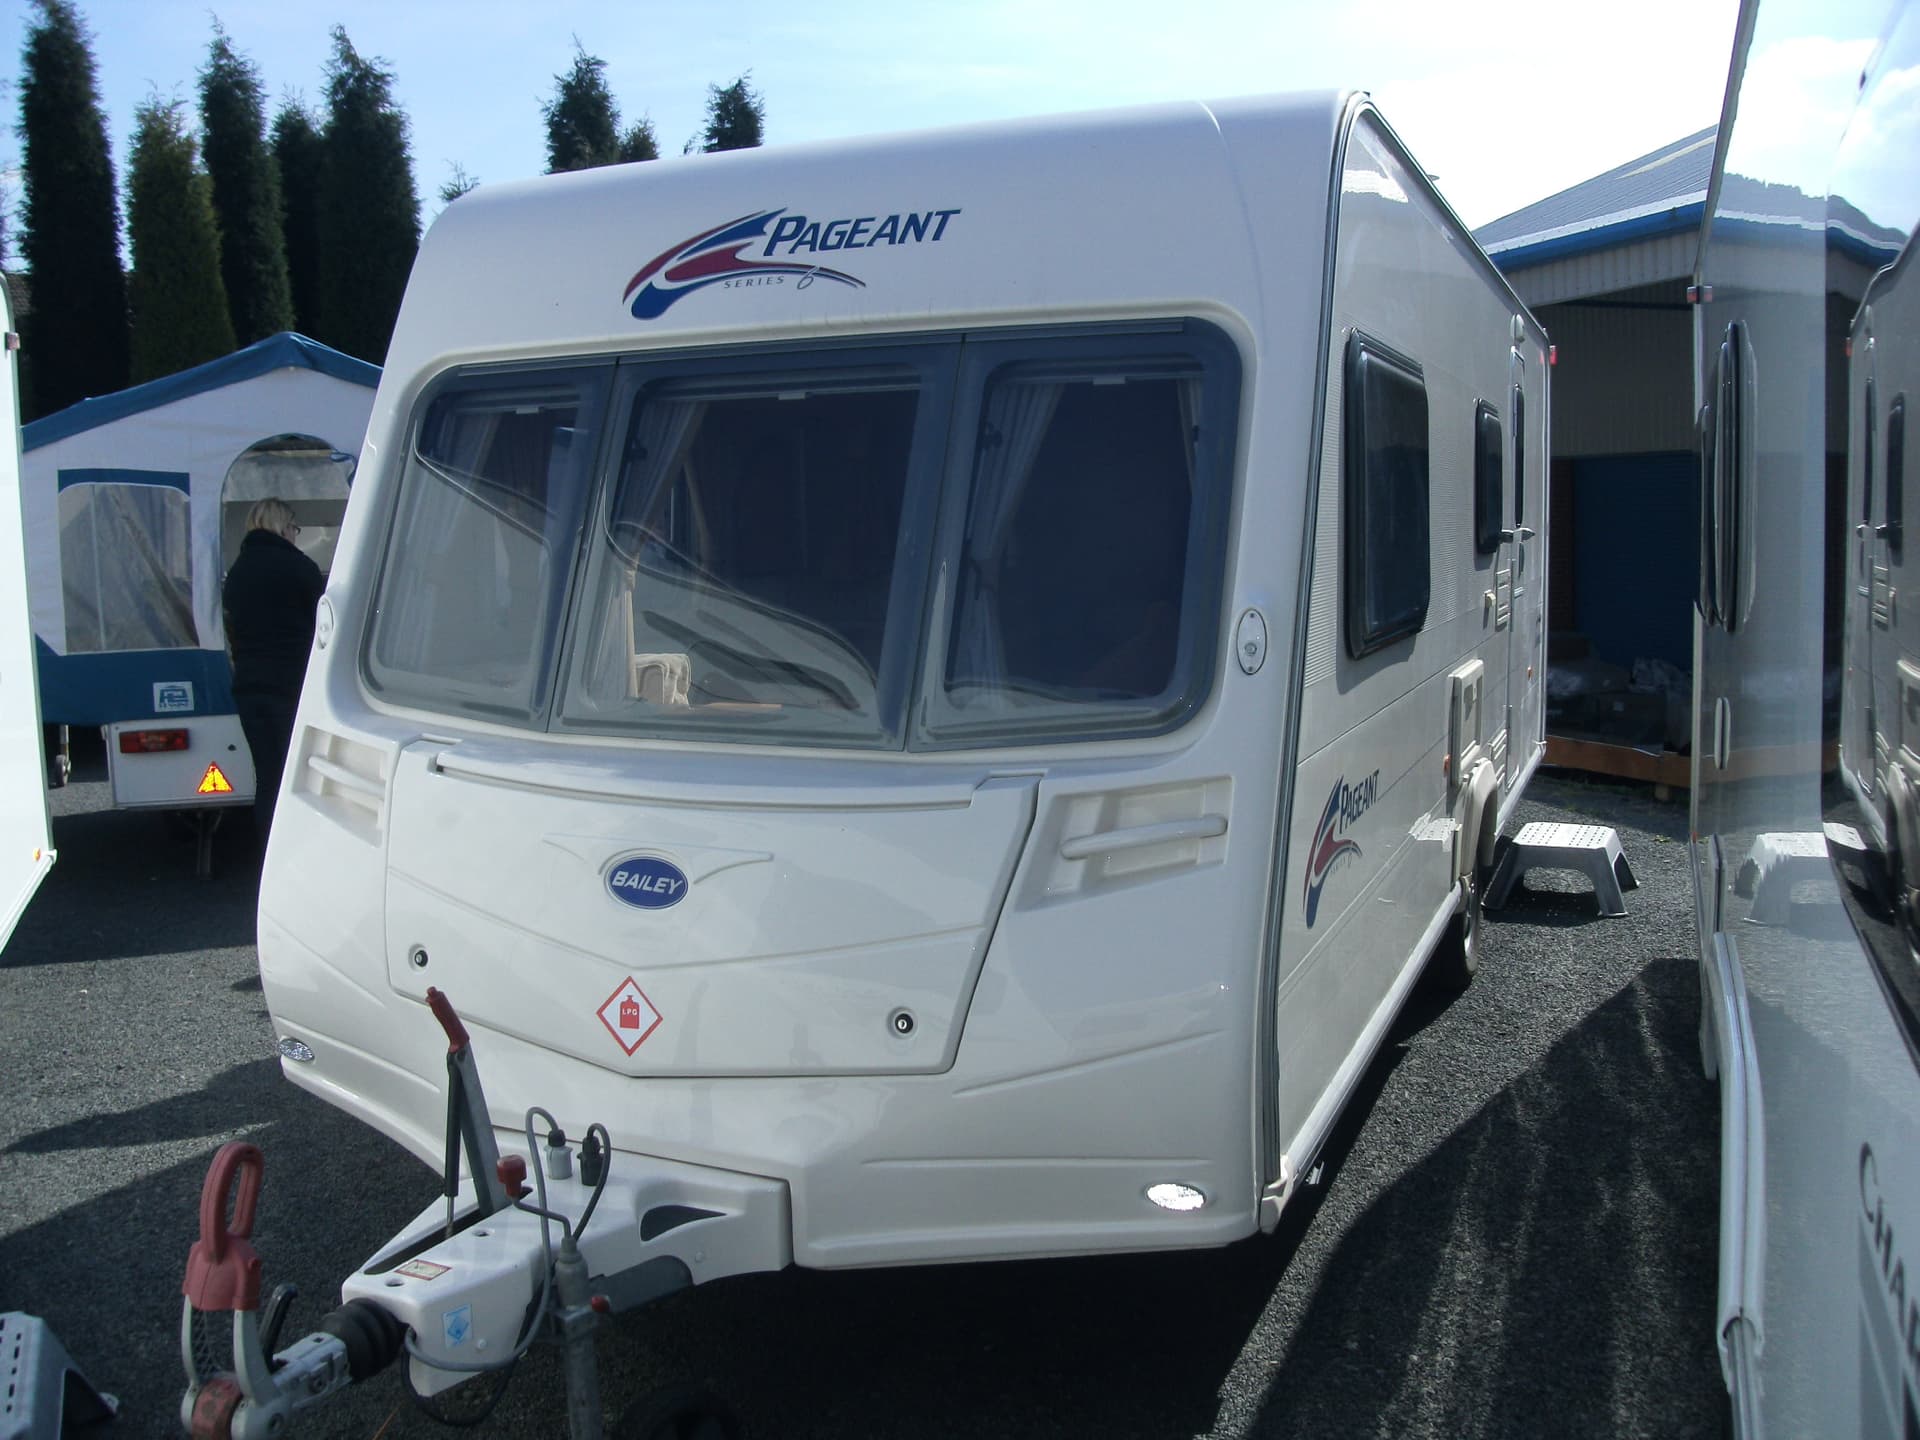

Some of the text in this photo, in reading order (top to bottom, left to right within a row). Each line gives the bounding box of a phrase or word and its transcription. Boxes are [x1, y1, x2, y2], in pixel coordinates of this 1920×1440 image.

[763, 208, 962, 257] PAGEANT
[723, 275, 785, 289] SERIES
[1339, 768, 1380, 835] PAGEANT
[612, 870, 683, 895] BAILEY
